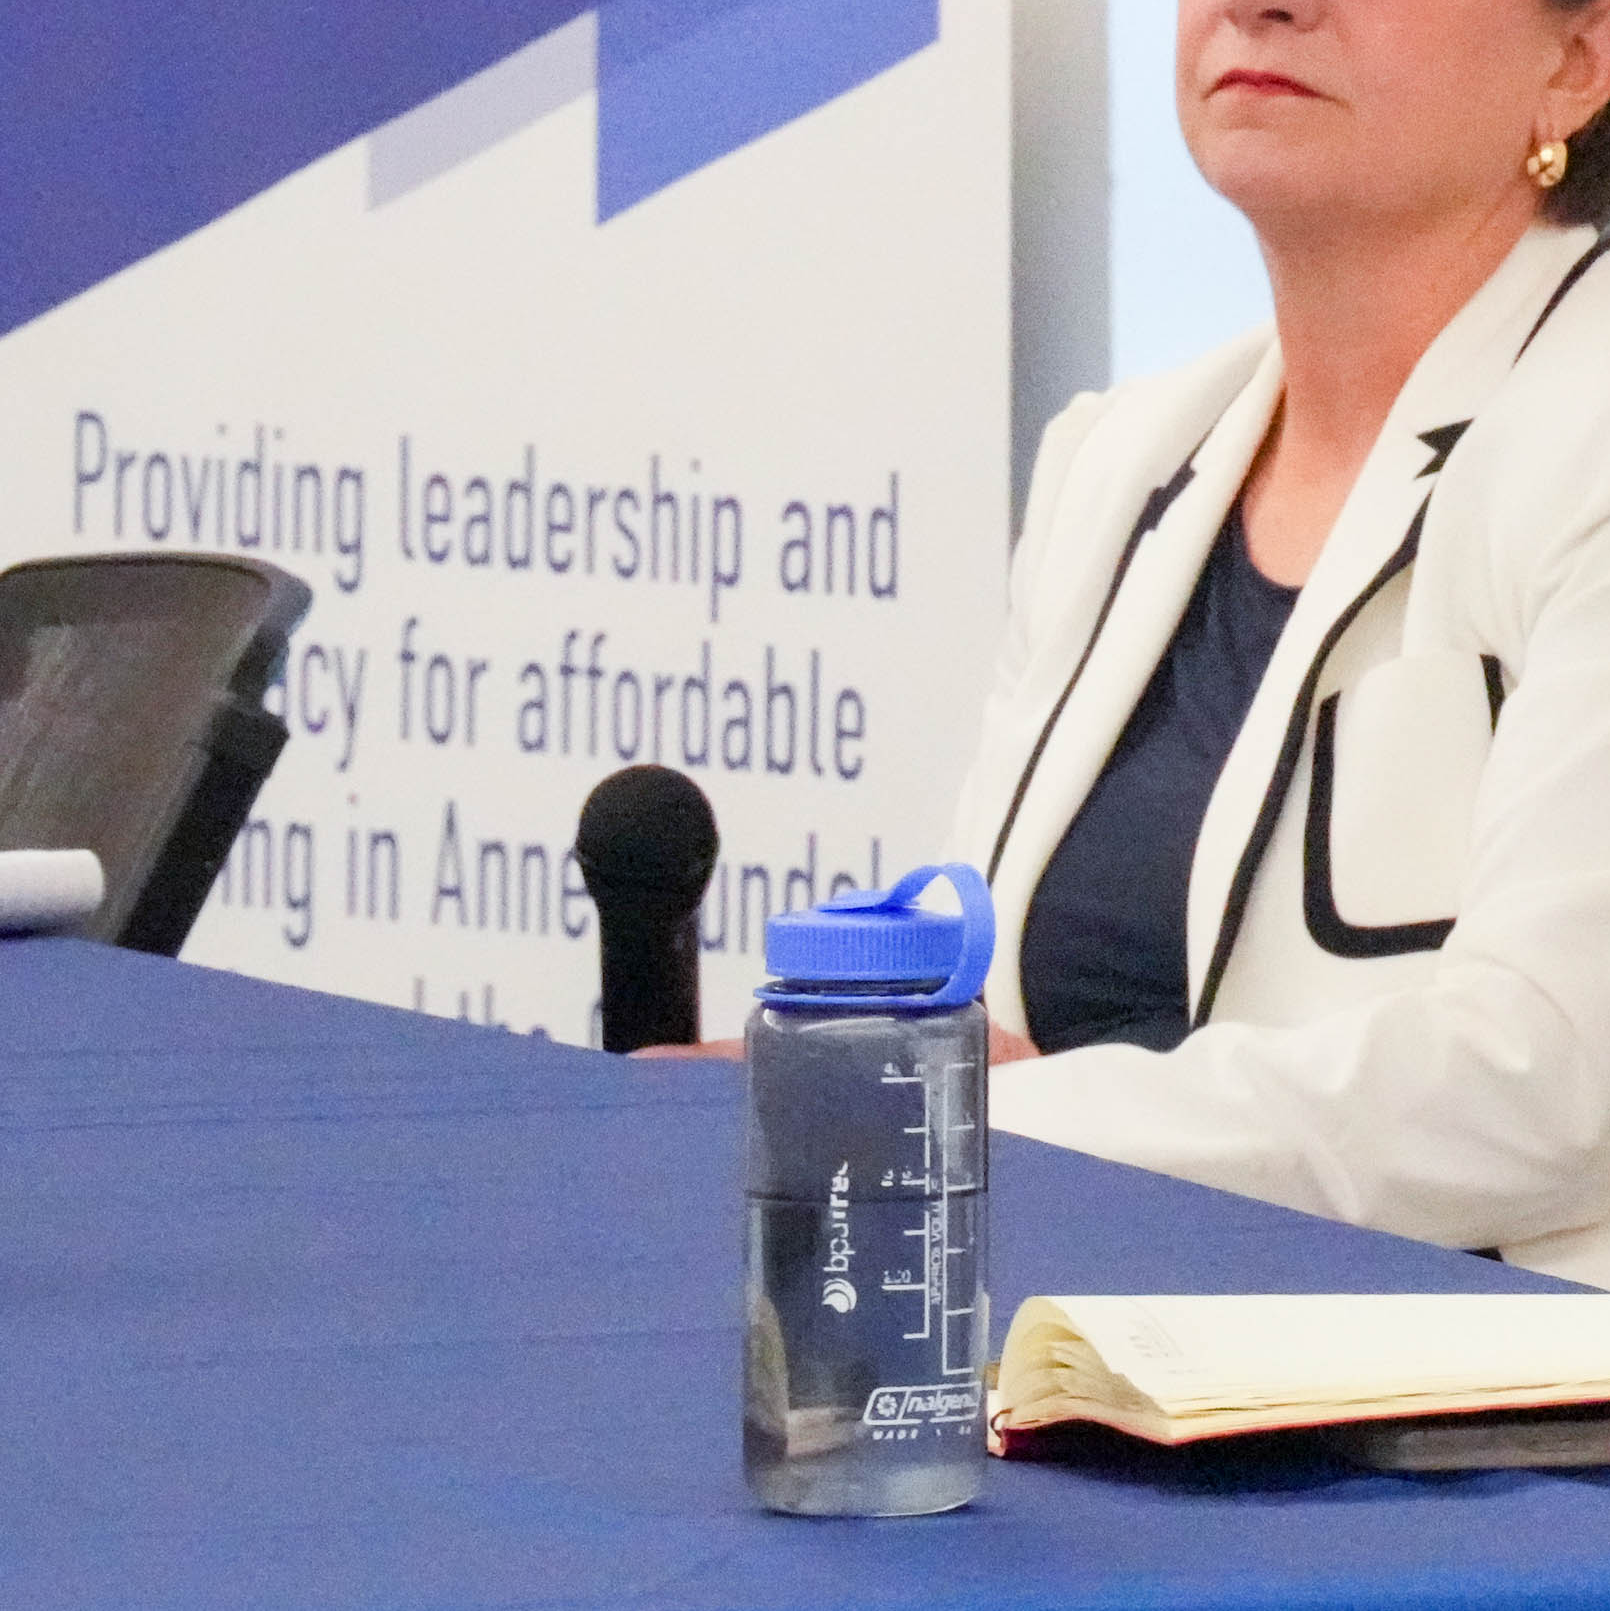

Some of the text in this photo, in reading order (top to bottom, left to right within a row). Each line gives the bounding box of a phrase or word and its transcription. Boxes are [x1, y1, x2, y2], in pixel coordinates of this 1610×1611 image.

[72, 410, 900, 623] Providing leadership and
[398, 616, 489, 746] for
[517, 630, 867, 782] affordable
[346, 792, 400, 921] in
[430, 799, 590, 940] Anne
